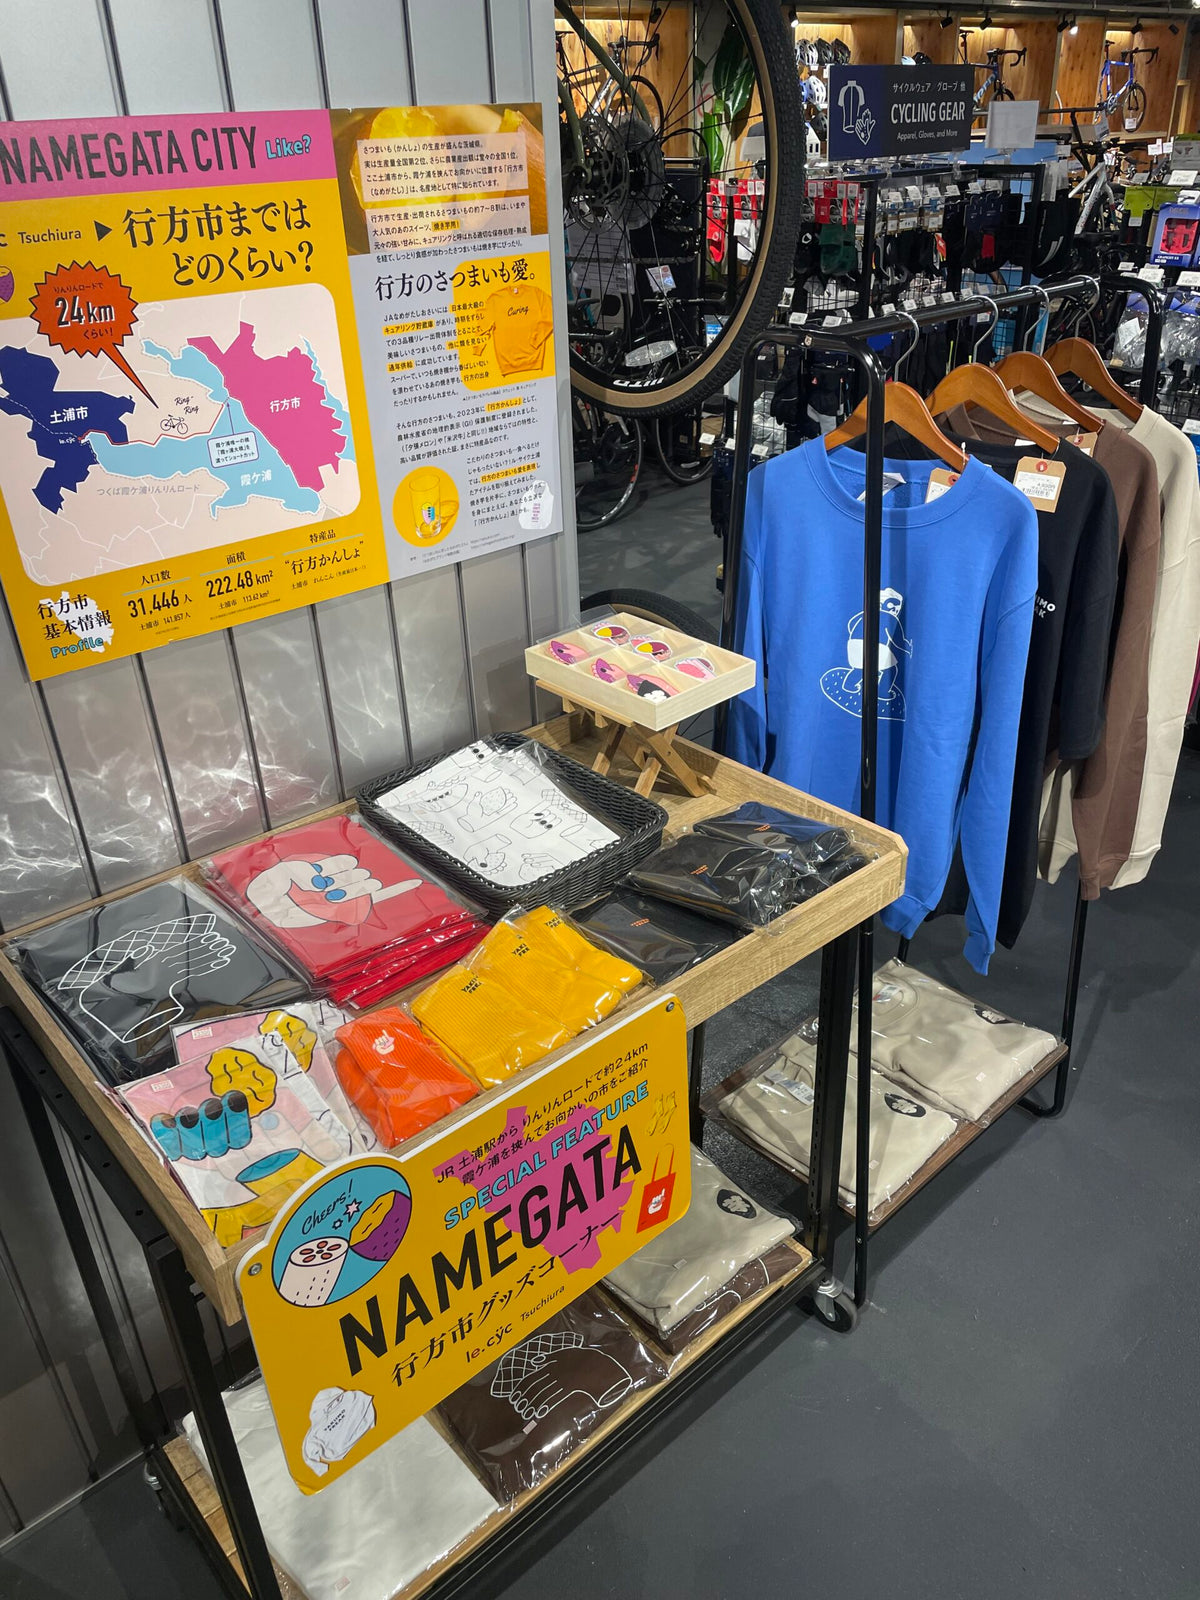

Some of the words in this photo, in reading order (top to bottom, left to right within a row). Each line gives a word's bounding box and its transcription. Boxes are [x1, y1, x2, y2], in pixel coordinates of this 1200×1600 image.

[892, 81, 932, 93] サイクルウェア
[937, 80, 959, 92] グローブ
[891, 102, 936, 124] CYCLING
[938, 101, 966, 122] GEAR
[897, 132, 917, 141] Apparel,
[918, 130, 936, 140] Gloves,
[936, 129, 945, 137] and
[946, 129, 958, 137] More
[0, 129, 188, 185] NAMEGATA
[191, 126, 257, 172] CITY
[265, 135, 312, 159] Like?
[18, 227, 82, 244] Tsuchiura
[123, 198, 312, 248] 行方市までは
[171, 240, 313, 286] どのくらい？
[53, 281, 104, 293] りんりんロードで
[374, 258, 535, 302] 行方のさつまいも愛。
[507, 305, 529, 317] Curing
[84, 327, 114, 341] くらい！
[50, 406, 89, 425] 土浦市
[269, 397, 302, 413] 行方市
[309, 529, 336, 544] 特産品
[226, 550, 247, 565] 面積
[141, 569, 172, 586] 人口数
[206, 569, 254, 598] 222.48
[36, 593, 89, 621] 行方市
[41, 610, 113, 641] 基本情報
[51, 635, 104, 659] Profile
[437, 1163, 455, 1185] JR
[457, 1122, 519, 1168] 土浦駅から
[444, 1152, 547, 1231] SPECIAL
[551, 1080, 650, 1157] FEATURE
[301, 1178, 354, 1236] Cheers!
[339, 1124, 642, 1377] NAMEGATA
[391, 1211, 622, 1388] 行方市グッズコーナー
[520, 1285, 566, 1322] Tsuchiura
